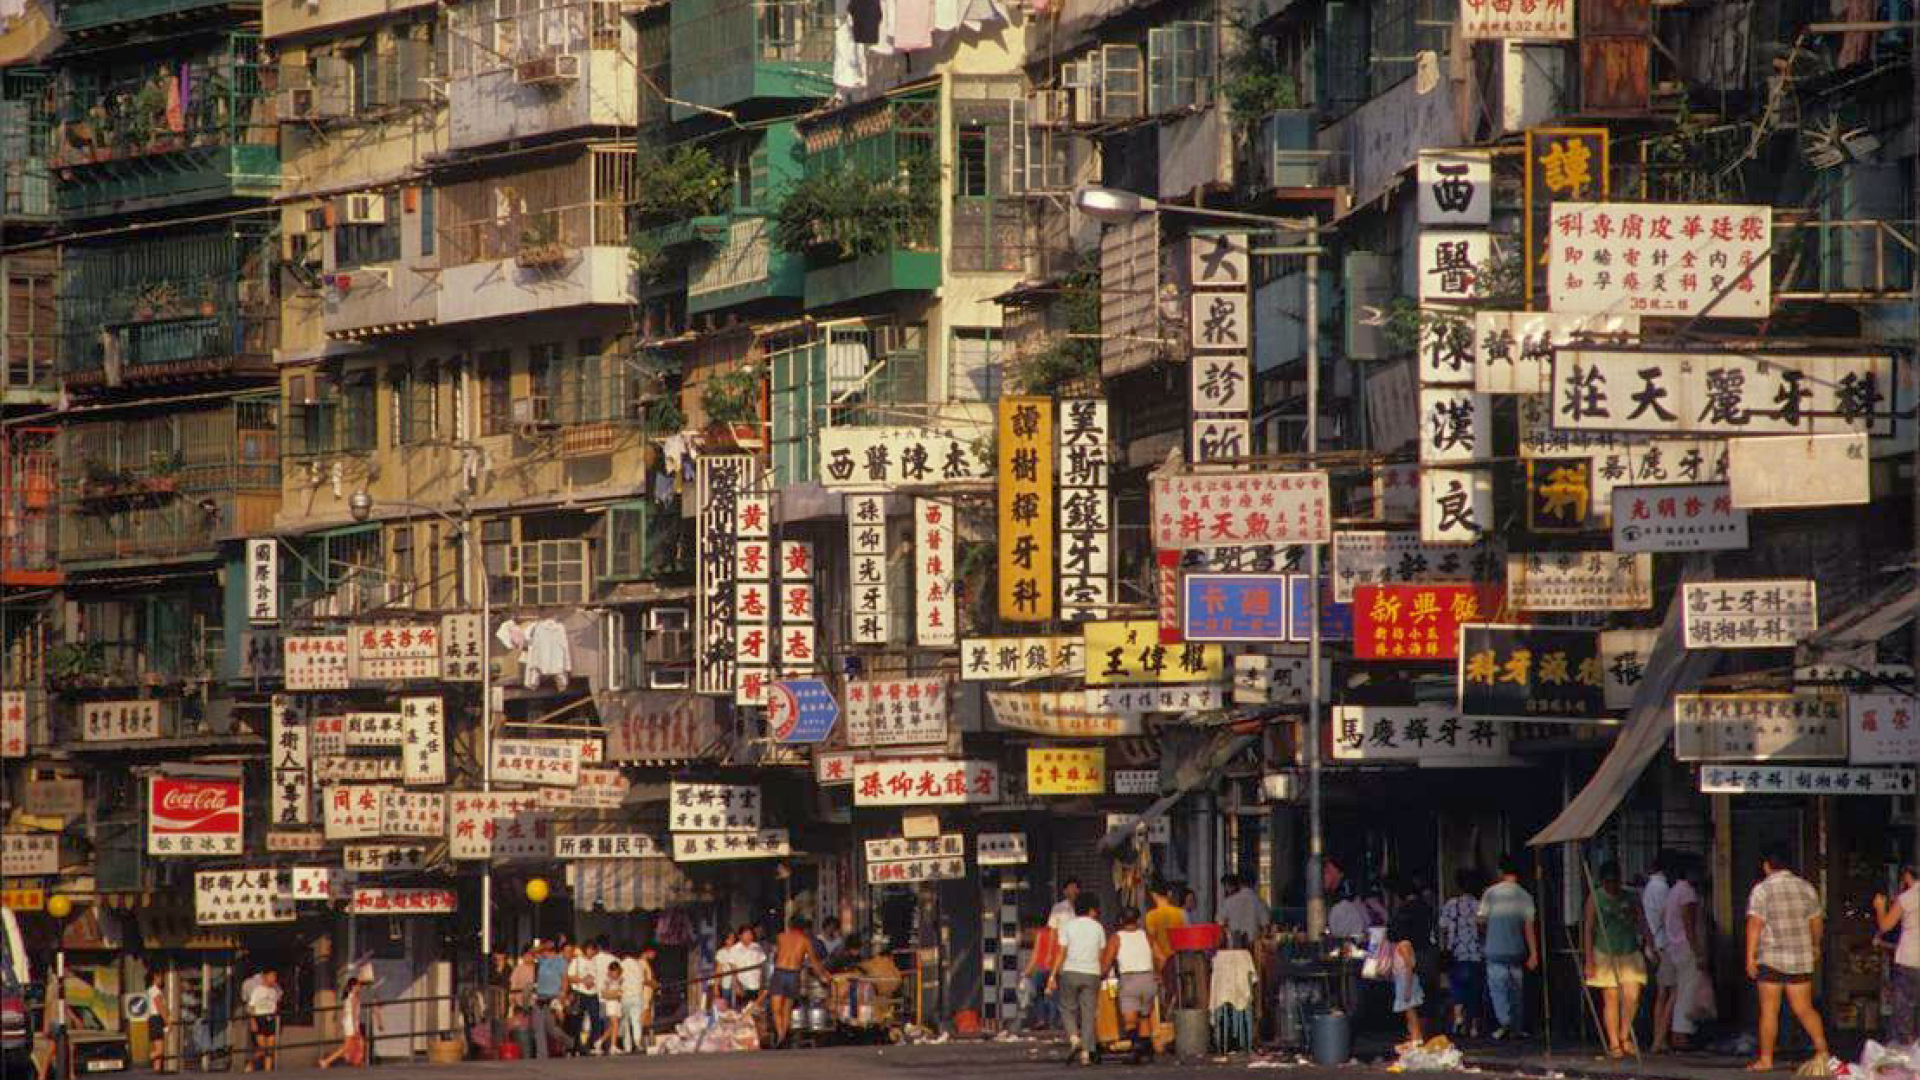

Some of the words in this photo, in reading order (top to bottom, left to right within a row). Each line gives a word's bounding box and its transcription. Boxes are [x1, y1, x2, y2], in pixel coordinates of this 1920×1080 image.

[1560, 365, 1883, 428] 莊天麗牙科
[827, 441, 994, 481] 西醫陳杰
